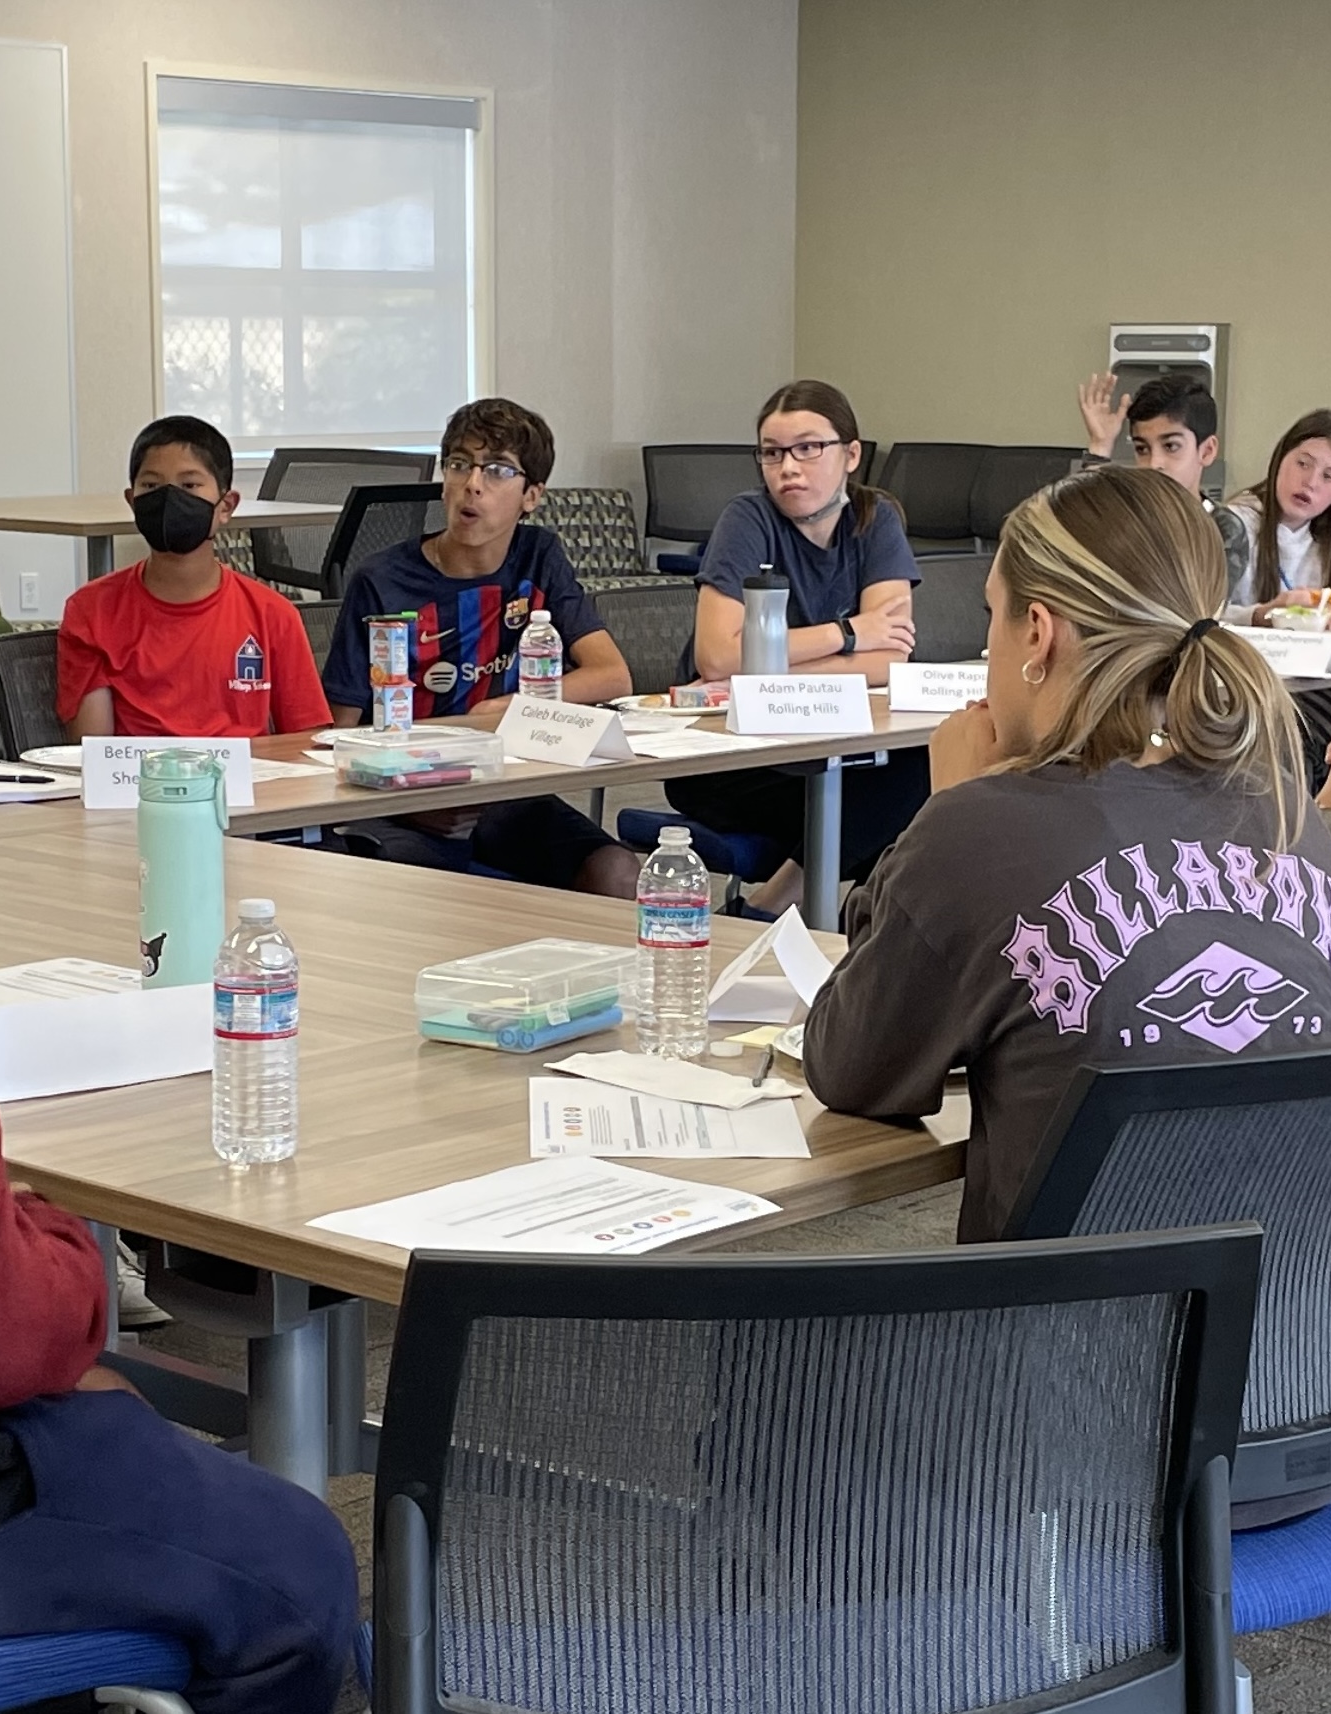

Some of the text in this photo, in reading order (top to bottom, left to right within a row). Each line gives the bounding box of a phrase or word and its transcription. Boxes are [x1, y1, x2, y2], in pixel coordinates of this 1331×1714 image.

[922, 669, 955, 681] Olive
[759, 682, 843, 694] Adam Pautau
[921, 686, 964, 698] Rolling
[521, 705, 549, 720] Caleb
[767, 703, 840, 716] Rolling Hills
[529, 729, 563, 746] Village
